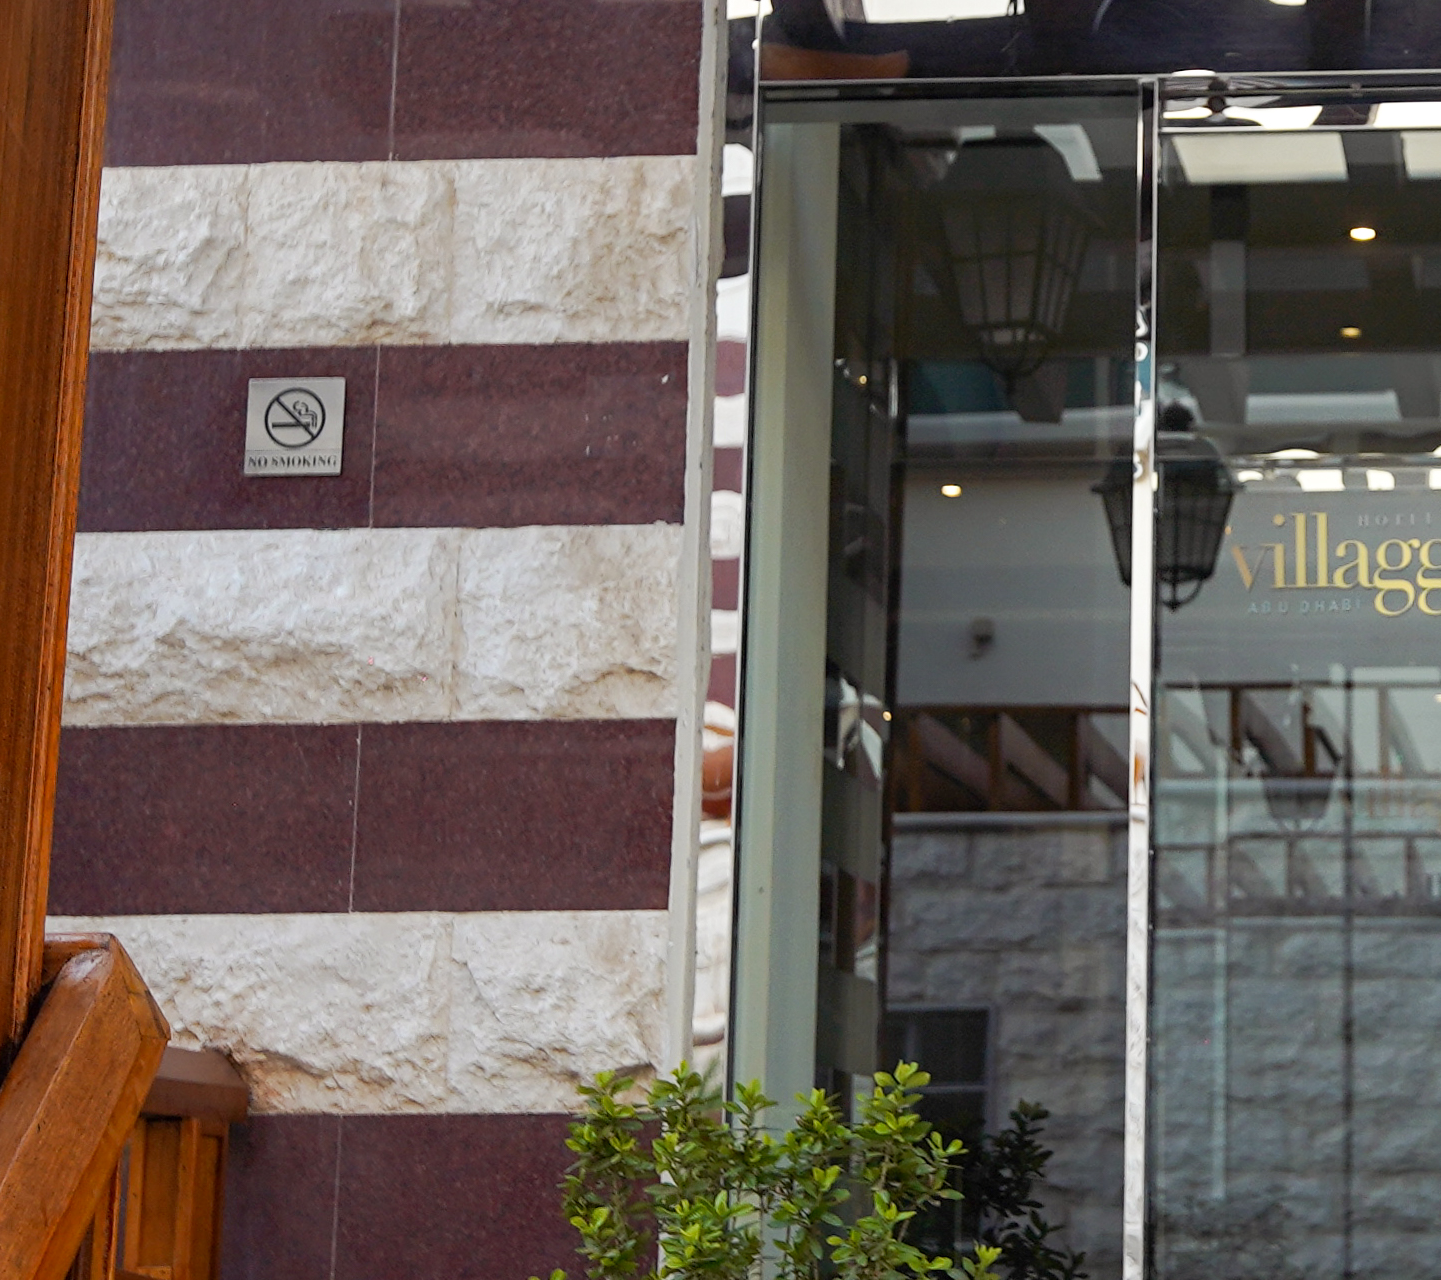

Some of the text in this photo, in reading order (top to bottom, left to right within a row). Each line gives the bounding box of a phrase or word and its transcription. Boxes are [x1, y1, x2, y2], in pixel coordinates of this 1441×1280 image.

[247, 454, 337, 468] NO SMOKING
[1247, 599, 1290, 615] ABU
